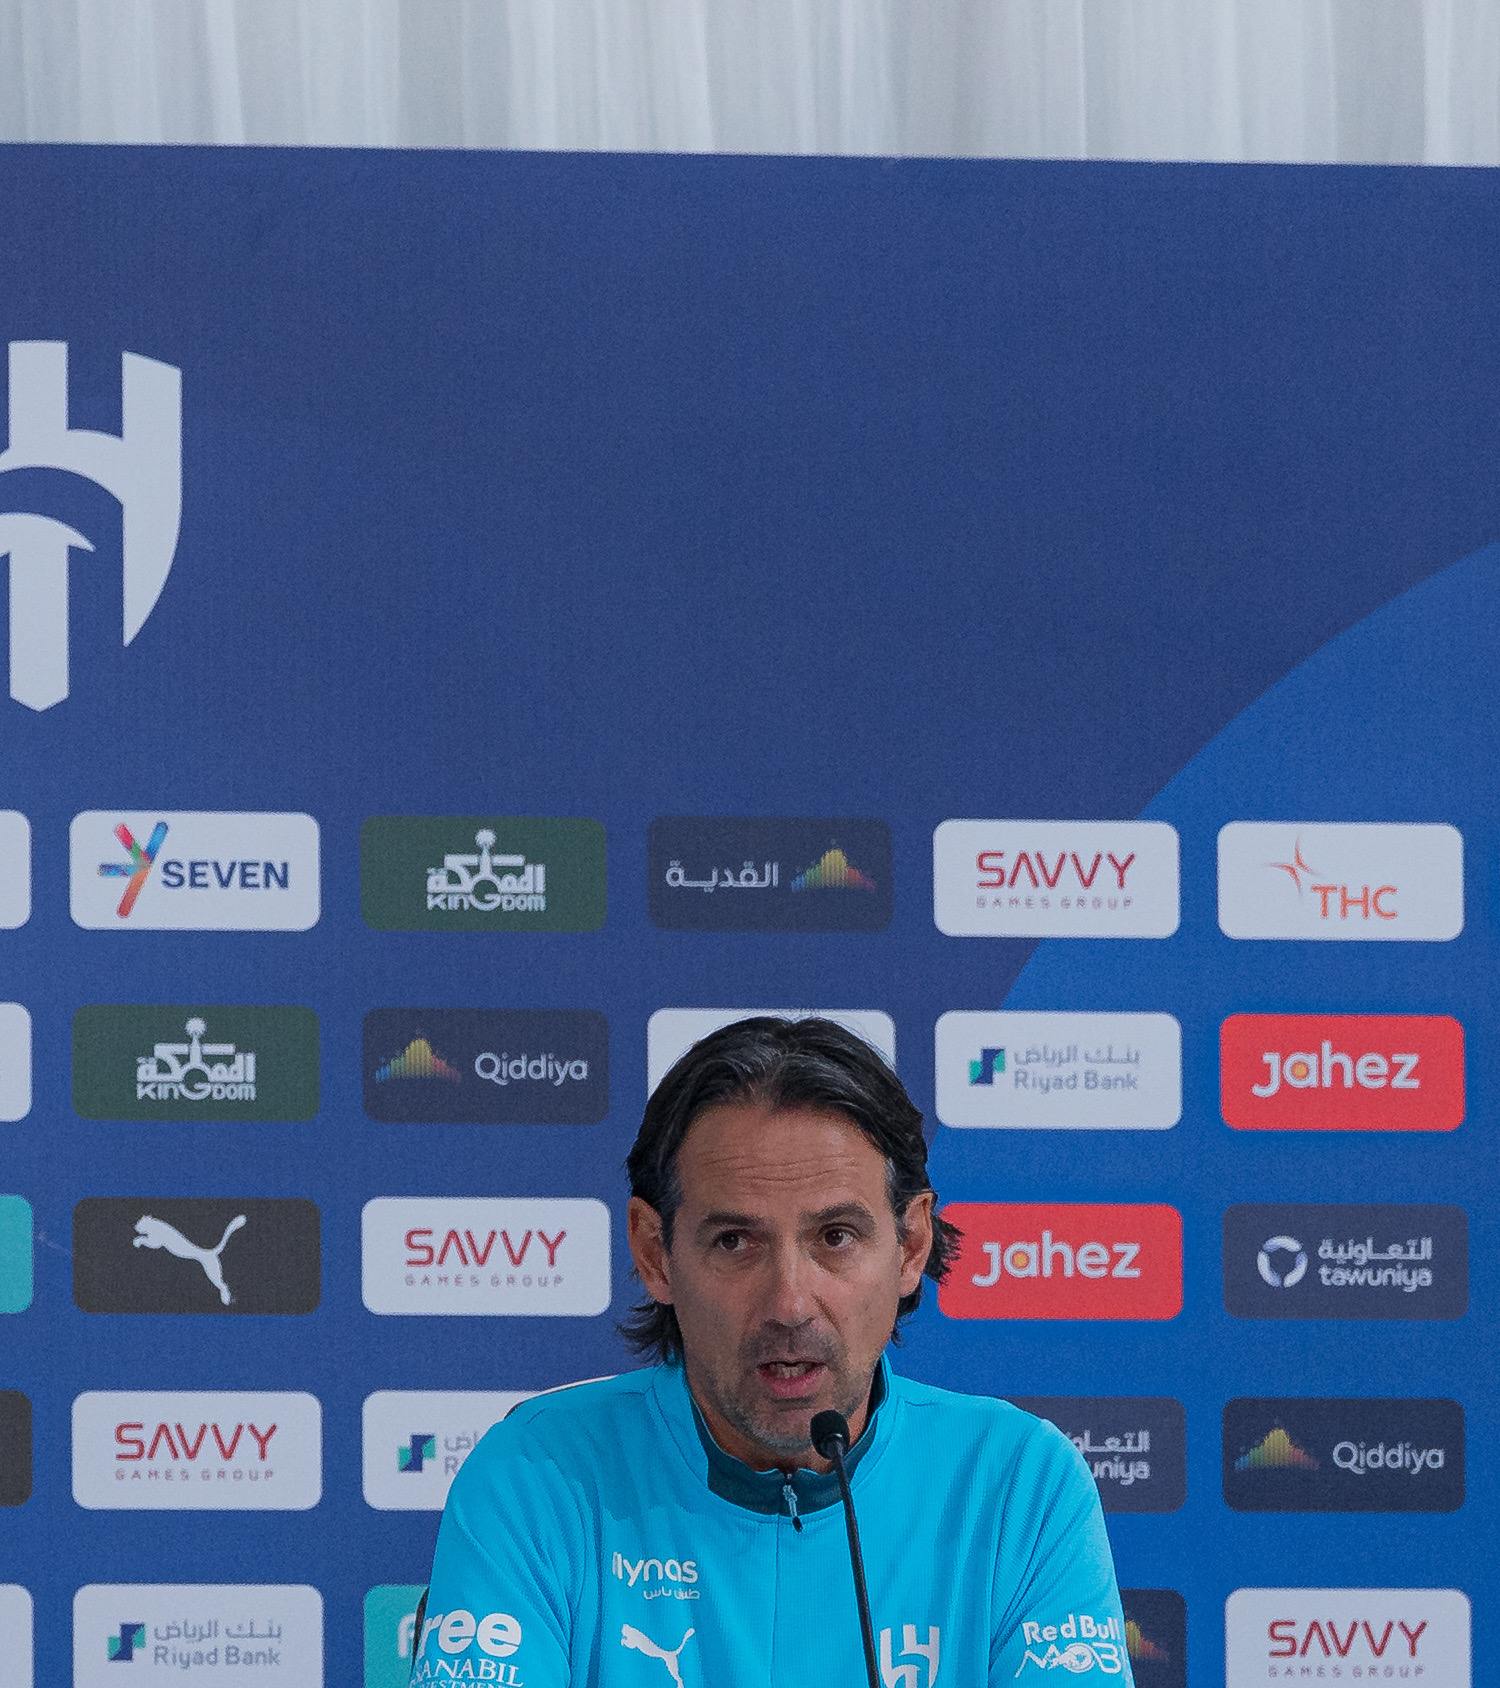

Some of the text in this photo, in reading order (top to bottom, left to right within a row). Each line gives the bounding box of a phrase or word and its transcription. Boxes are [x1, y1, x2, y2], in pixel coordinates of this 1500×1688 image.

[163, 860, 290, 890] SEVEN
[666, 862, 778, 891] القدية
[975, 851, 1136, 890] SAVVY
[1312, 885, 1399, 921] THC
[475, 1051, 587, 1086] Qiddiya
[1014, 1072, 1139, 1095] Riyad Bank
[404, 1229, 566, 1268] SAVVY
[1317, 1265, 1433, 1293] tawuniya
[114, 1423, 277, 1462] SAVVY
[1333, 1440, 1444, 1475] Qiddiya
[1022, 1613, 1077, 1646] Red
[1267, 1619, 1427, 1658] SAVVY
[154, 1648, 280, 1671] Riyad Bank
